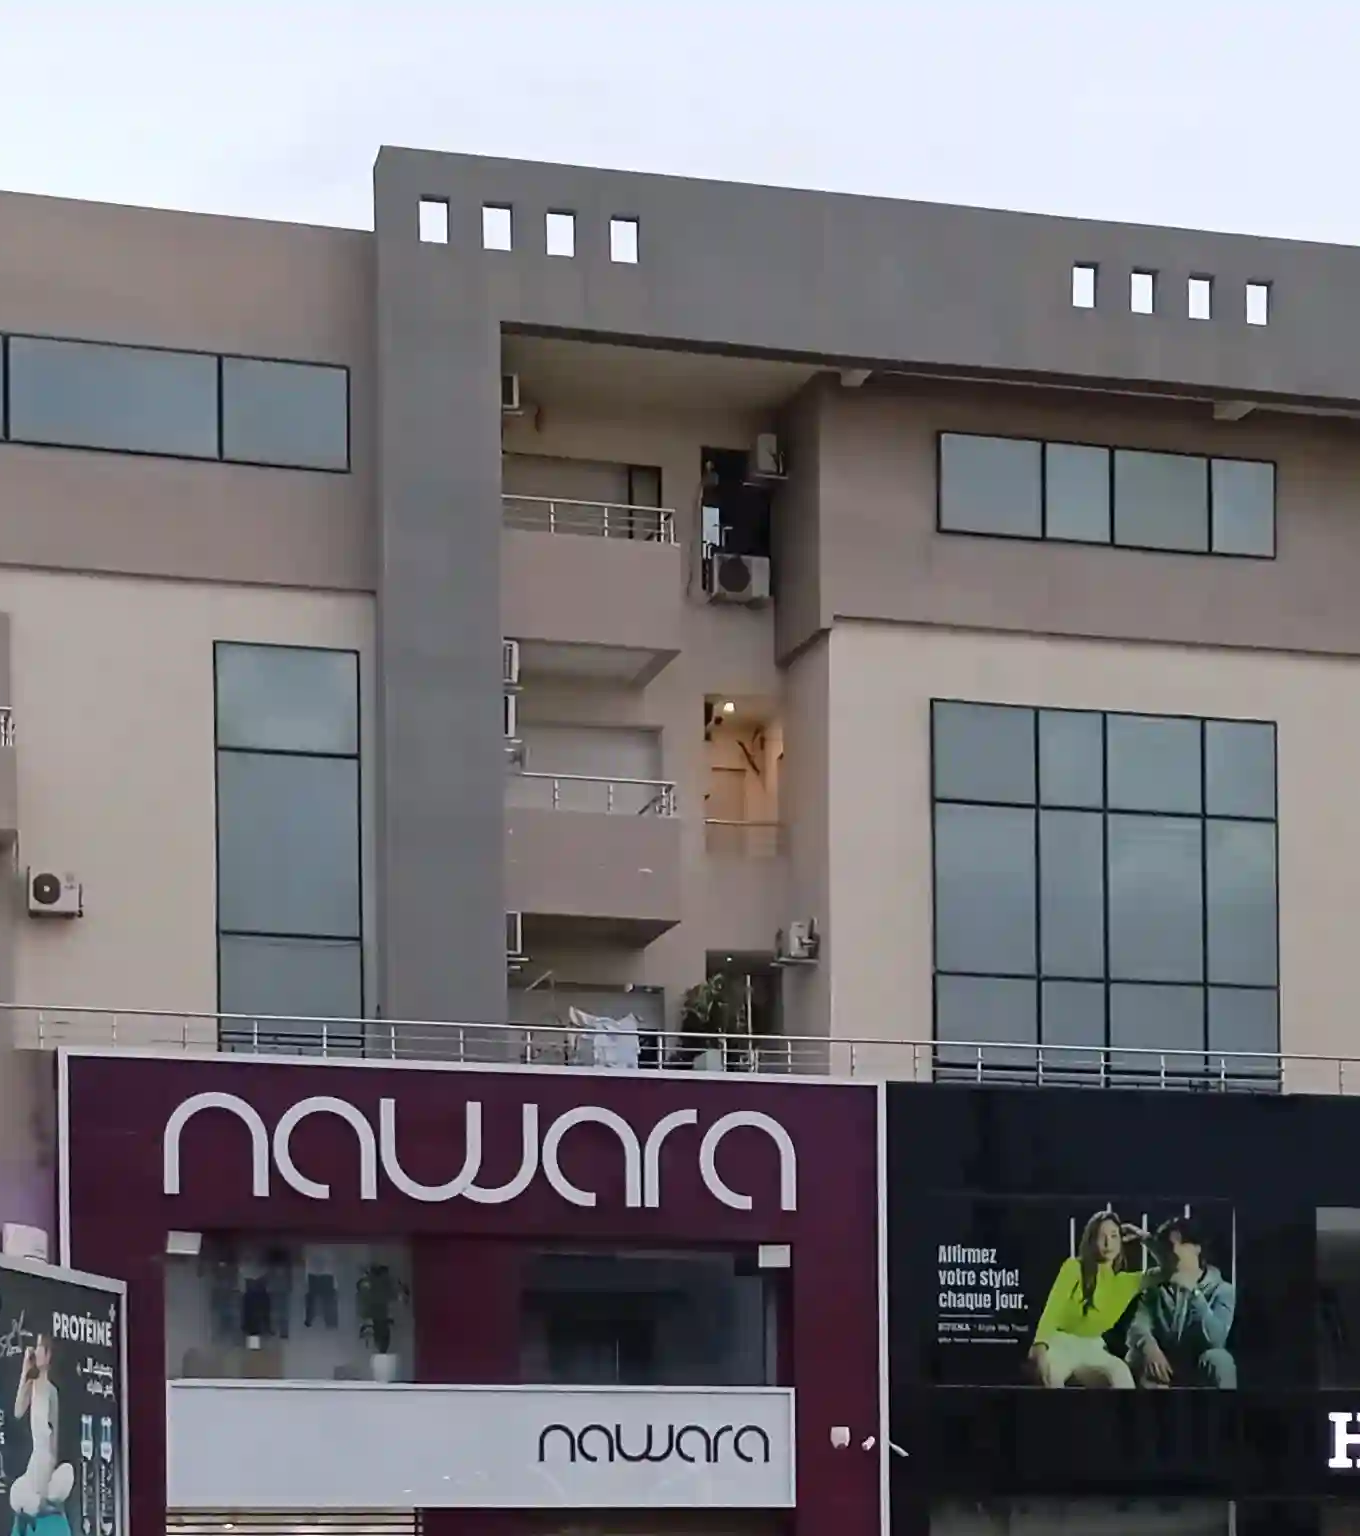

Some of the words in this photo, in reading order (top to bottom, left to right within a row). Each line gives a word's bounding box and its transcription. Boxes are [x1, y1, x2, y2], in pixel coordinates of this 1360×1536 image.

[163, 1091, 797, 1211] nawara
[938, 1268, 977, 1286] votre
[939, 1290, 991, 1311] chaque
[995, 1289, 1029, 1311] jour.
[537, 1422, 770, 1463] nawara
